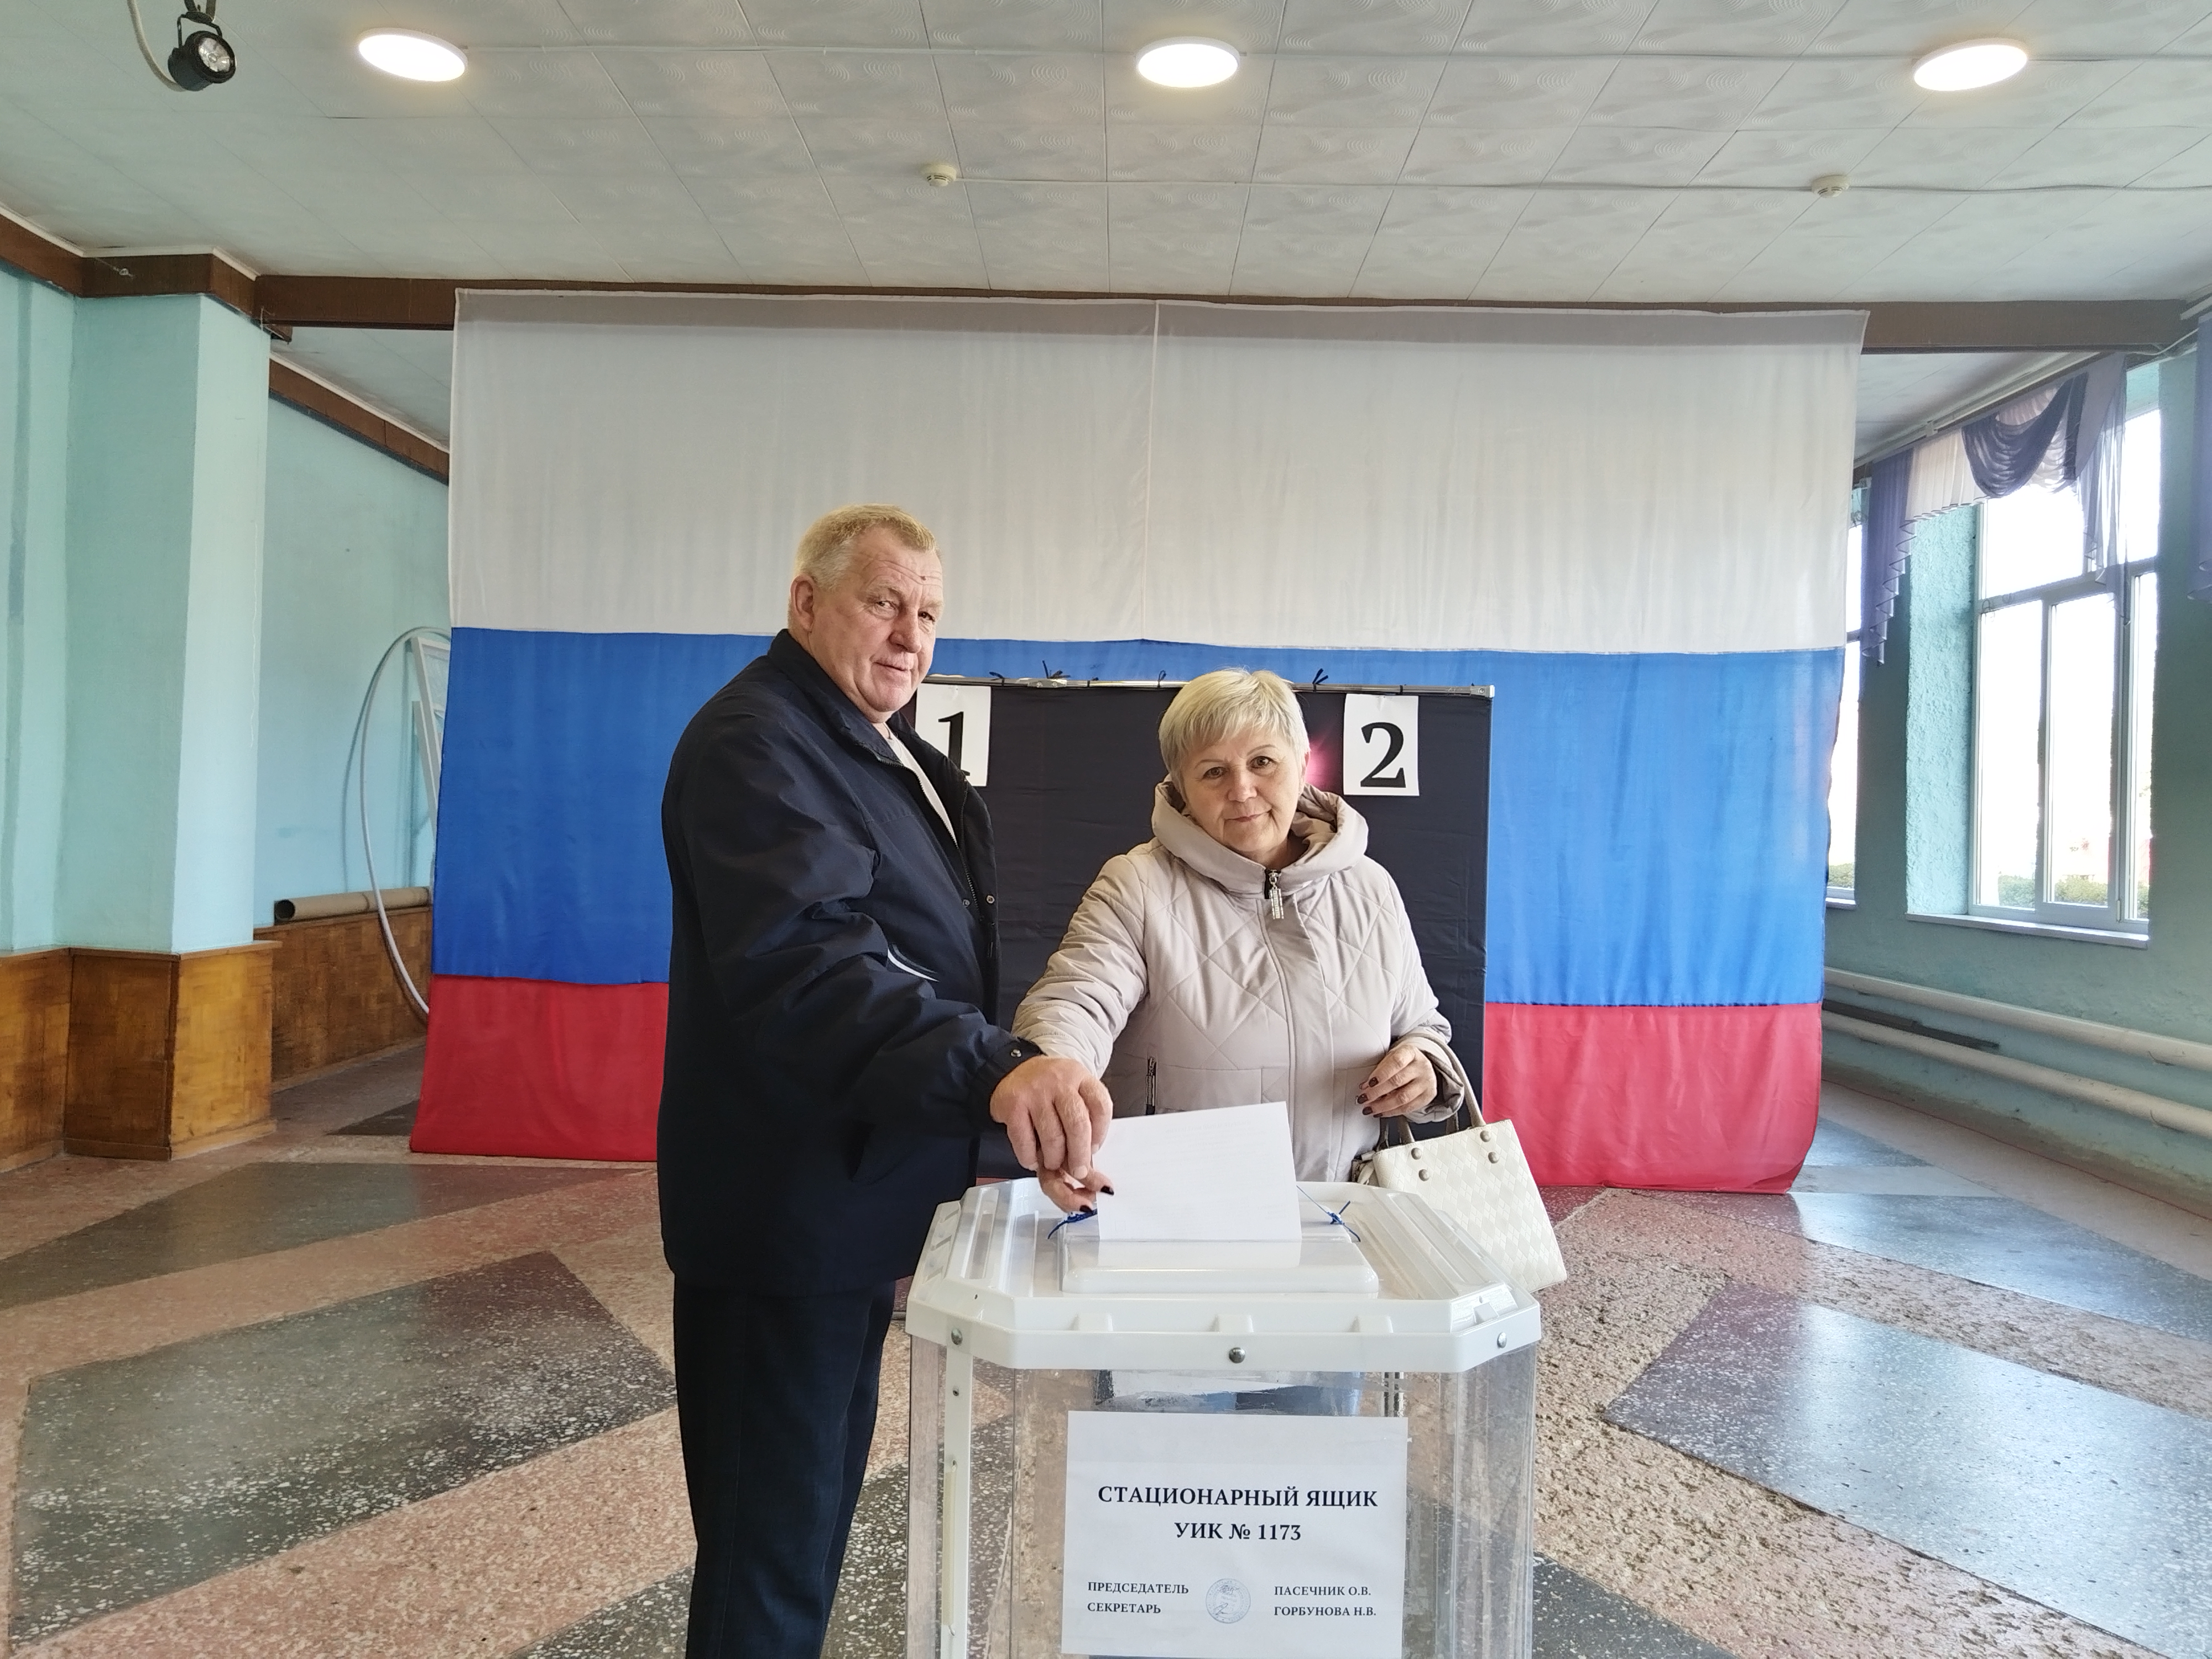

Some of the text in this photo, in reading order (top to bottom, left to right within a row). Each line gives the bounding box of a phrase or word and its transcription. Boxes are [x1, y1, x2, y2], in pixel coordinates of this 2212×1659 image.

[938, 711, 971, 776] 1
[1360, 722, 1406, 788] 2
[1098, 1485, 1379, 1510] СТАЦИОНАРНЫЙ ЯЩИК
[1173, 1522, 1301, 1541] УИК № 1173
[1087, 1581, 1371, 1596] ПРЕДСЕДАТЕЛЬ ПАСЕЧНИК О.В.
[1087, 1601, 1377, 1616] СЕКРЕТАРЬ ГОРБУНОВА Н.В.
